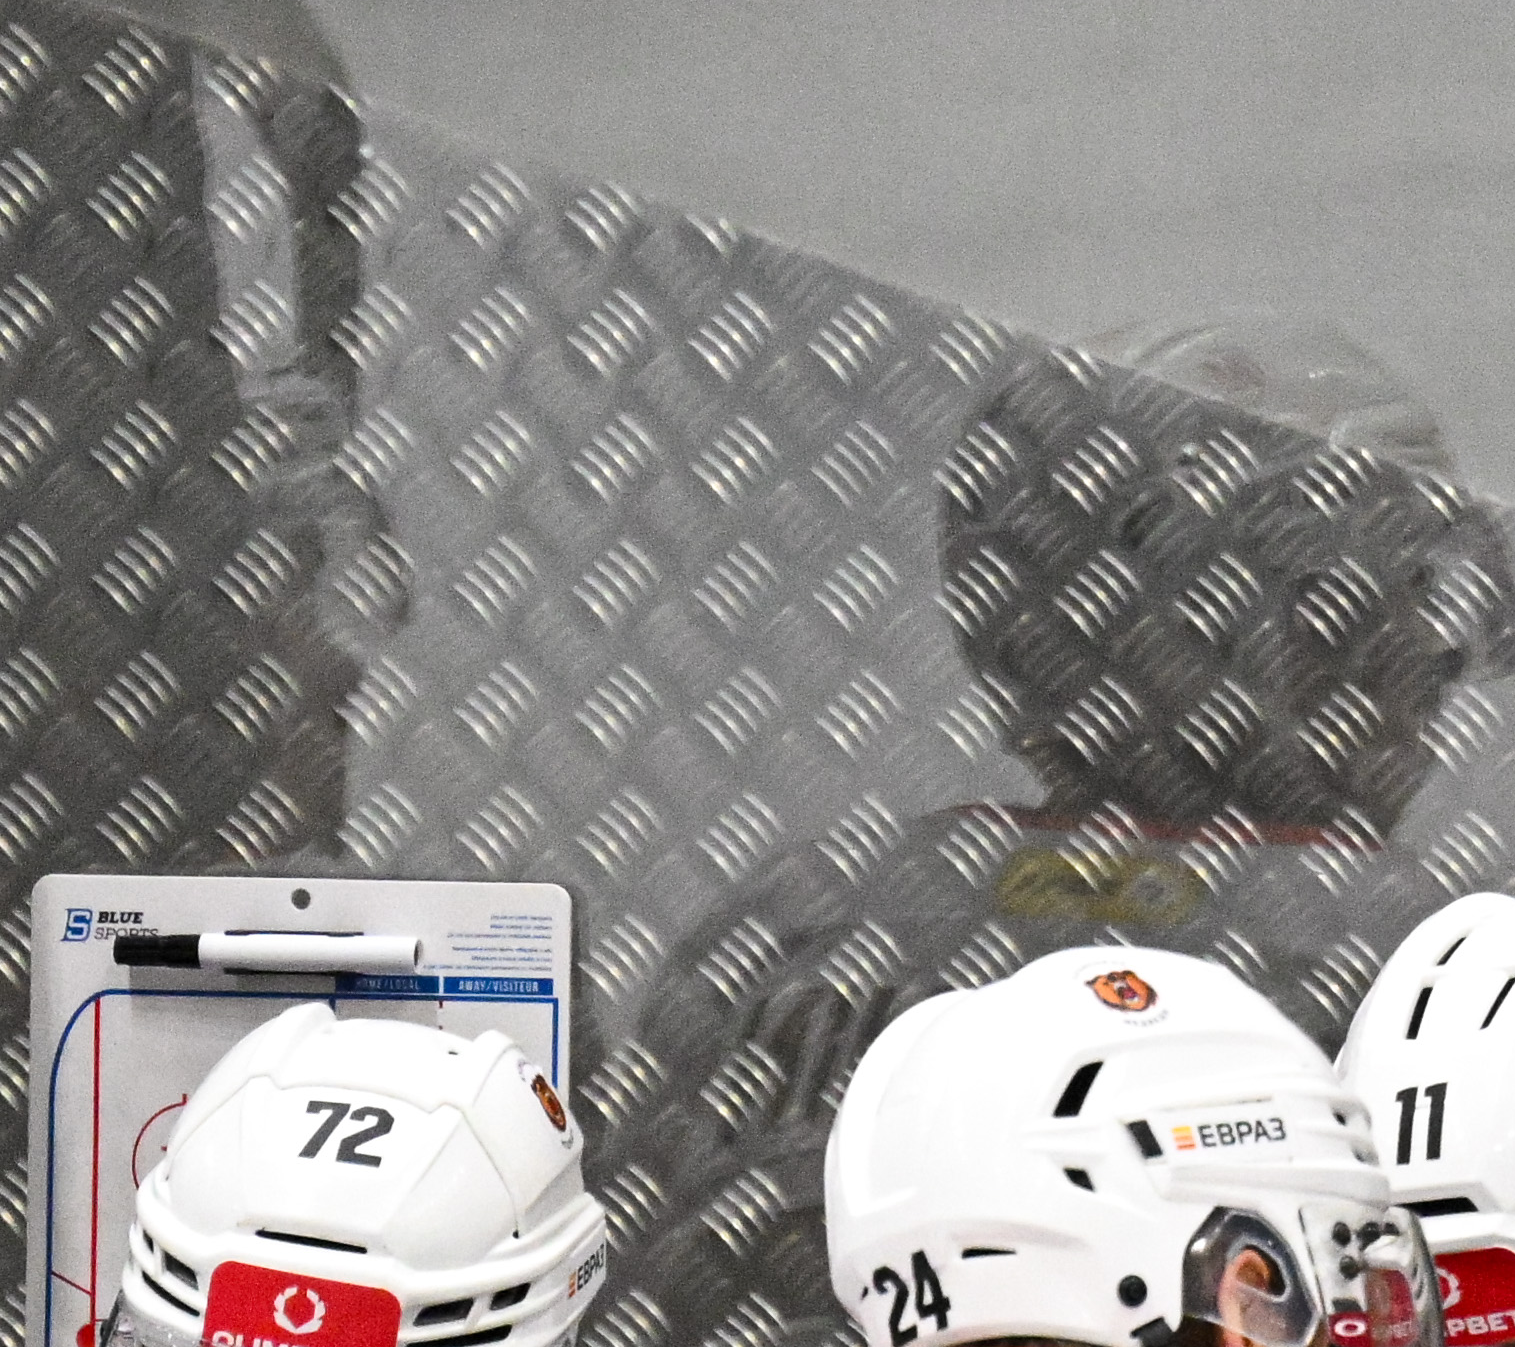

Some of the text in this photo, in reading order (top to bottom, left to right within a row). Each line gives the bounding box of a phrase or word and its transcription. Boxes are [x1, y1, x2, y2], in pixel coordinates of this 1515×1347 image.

[97, 911, 144, 924] BLUE
[298, 1100, 395, 1168] 72
[1199, 1117, 1287, 1149] ЕВРАЗ
[1396, 1082, 1449, 1165] 11
